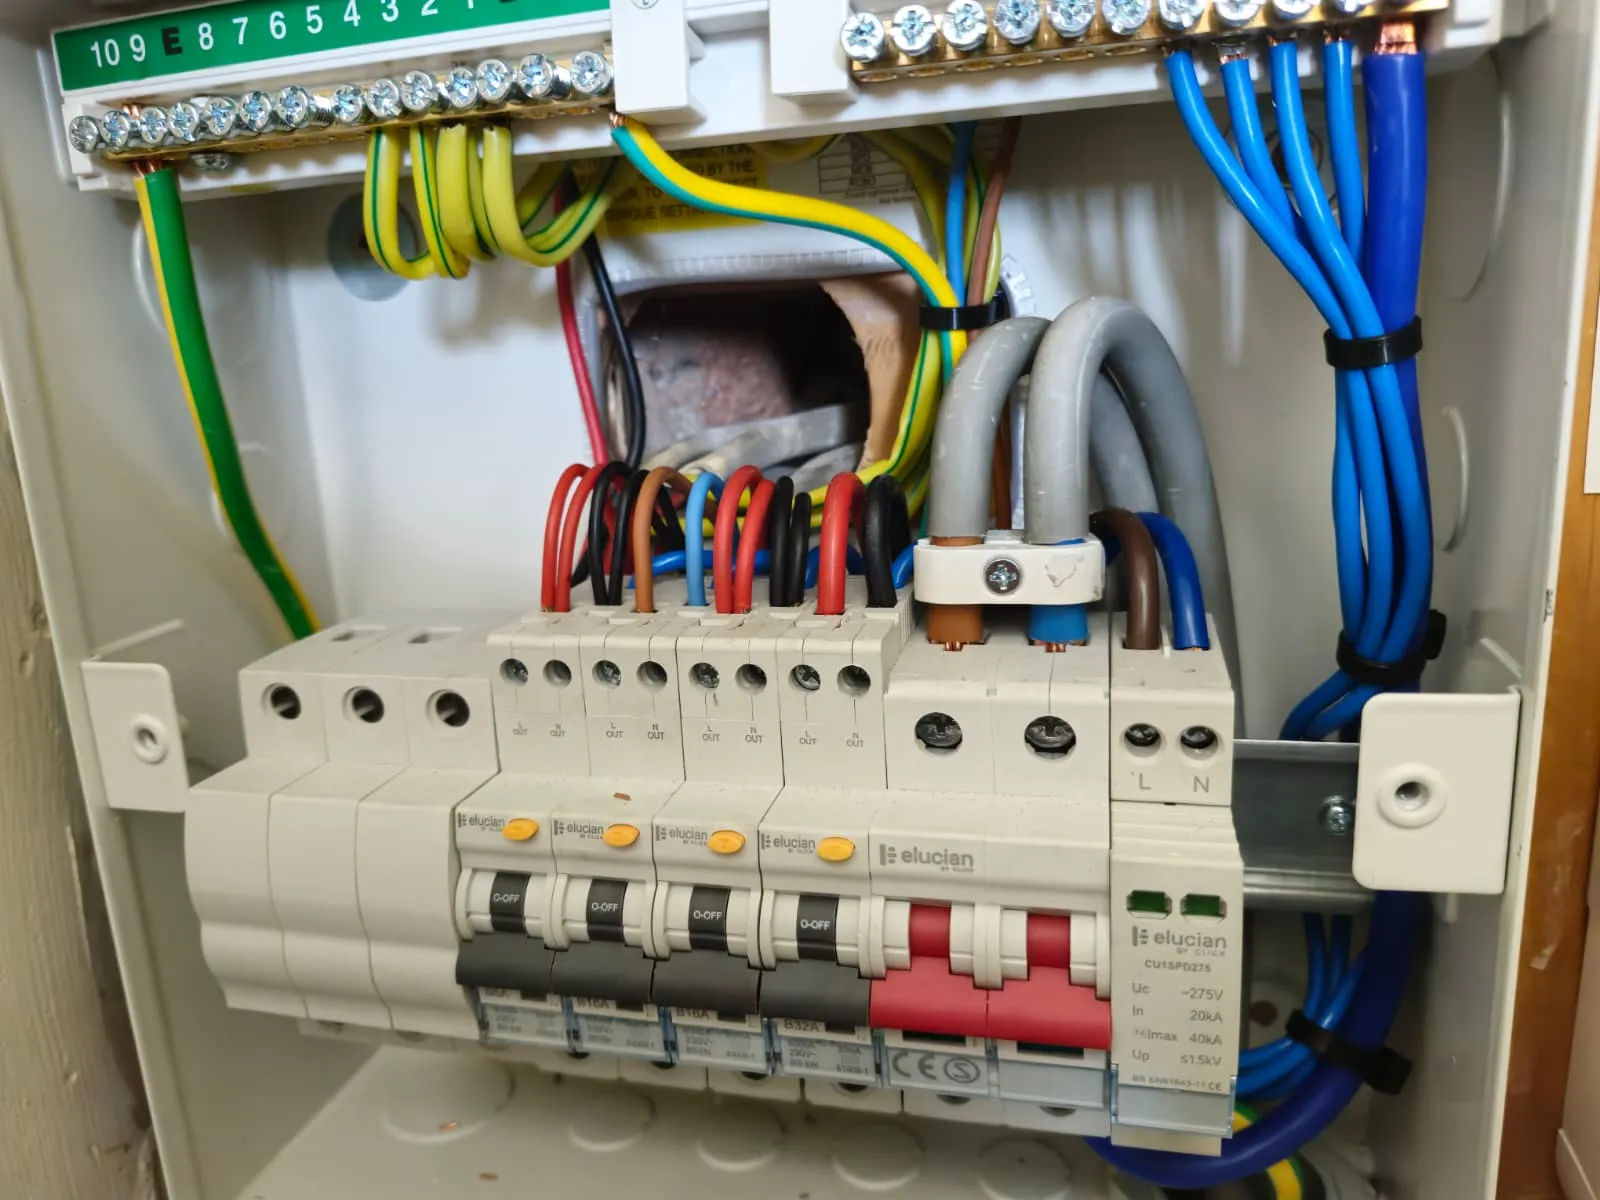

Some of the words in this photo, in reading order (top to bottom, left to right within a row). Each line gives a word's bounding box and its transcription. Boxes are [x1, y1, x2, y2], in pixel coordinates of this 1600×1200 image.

[90, 38, 120, 68] 10
[129, 34, 146, 62] 9
[161, 26, 183, 56] E
[198, 23, 214, 50] 8
[232, 16, 249, 45] 7
[269, 11, 287, 40] 6
[306, 5, 323, 34] 5
[343, 0, 361, 27] 4
[652, 723, 659, 731] N
[750, 726, 757, 734] N
[606, 730, 624, 738] OUT
[647, 731, 665, 740] OUT
[702, 733, 720, 742] OUT
[745, 734, 763, 743] OUT
[799, 737, 816, 745] OUT
[846, 739, 864, 748] OUT
[1139, 773, 1152, 790] L
[1193, 775, 1209, 793] N
[468, 814, 505, 827] elucian
[567, 822, 604, 835] elucian
[669, 827, 708, 841] elucian
[773, 834, 816, 849] elucian
[901, 846, 975, 867] elucian
[1153, 929, 1227, 949] elucian
[1131, 982, 1150, 995] Uc
[1189, 1009, 1223, 1023] 20kA
[783, 1019, 820, 1033] B32A
[1189, 1032, 1223, 1046] 40kA
[1131, 1049, 1150, 1063] Up
